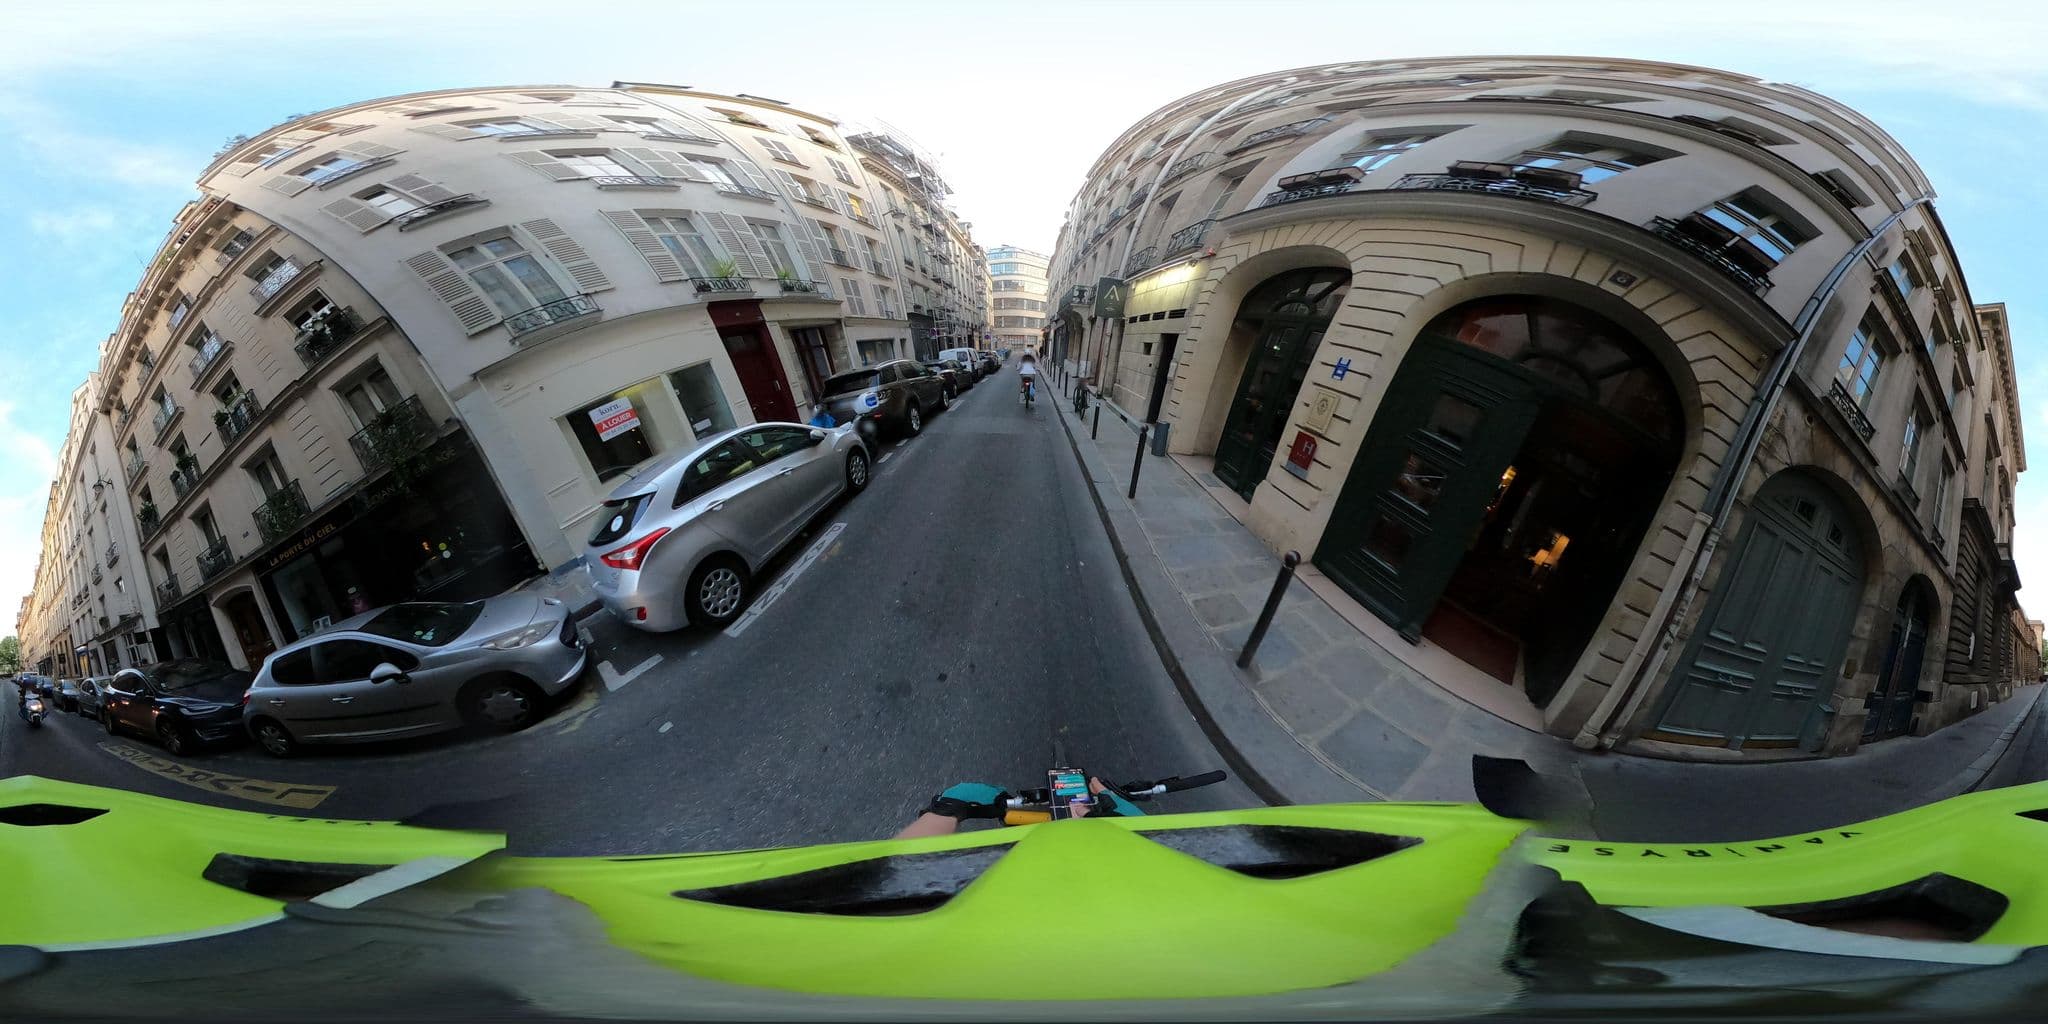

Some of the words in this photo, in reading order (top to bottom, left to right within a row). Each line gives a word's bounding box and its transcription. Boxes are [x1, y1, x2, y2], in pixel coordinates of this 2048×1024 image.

[608, 412, 632, 426] LOUER
[1303, 441, 1314, 454] H
[280, 543, 304, 561] PORTE
[304, 535, 316, 546] DU
[317, 523, 337, 538] CIEL
[734, 525, 842, 630] PAYANT
